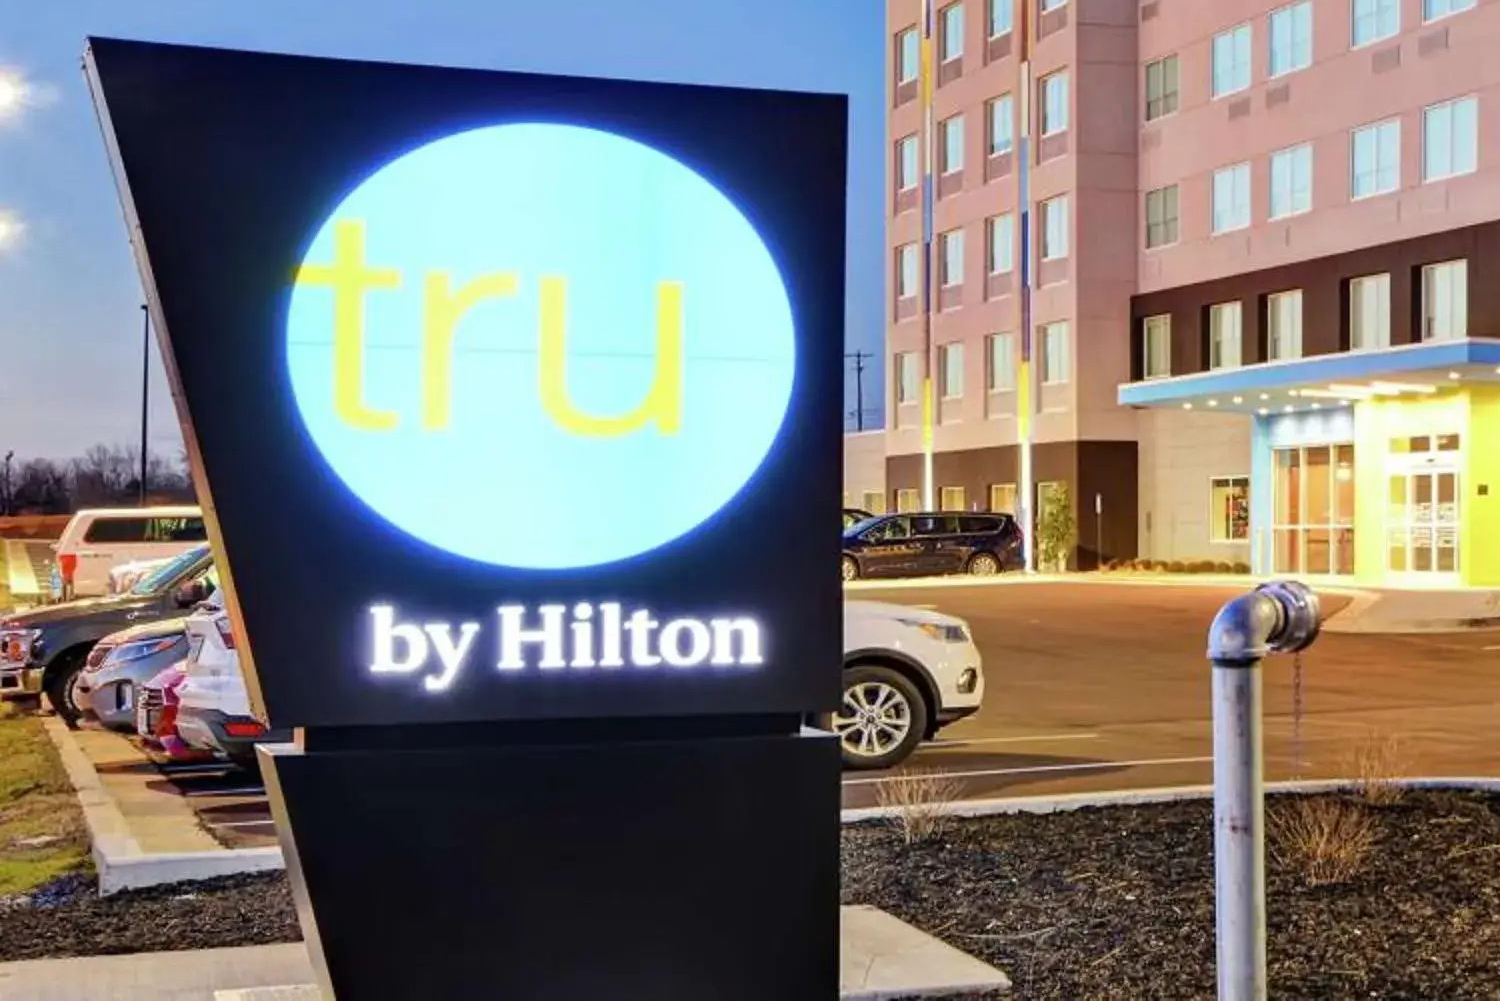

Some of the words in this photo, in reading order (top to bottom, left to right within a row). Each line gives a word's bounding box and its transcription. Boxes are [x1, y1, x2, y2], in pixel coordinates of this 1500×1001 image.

[293, 220, 683, 437] tru
[369, 604, 480, 691] by
[497, 602, 763, 669] Hilton
